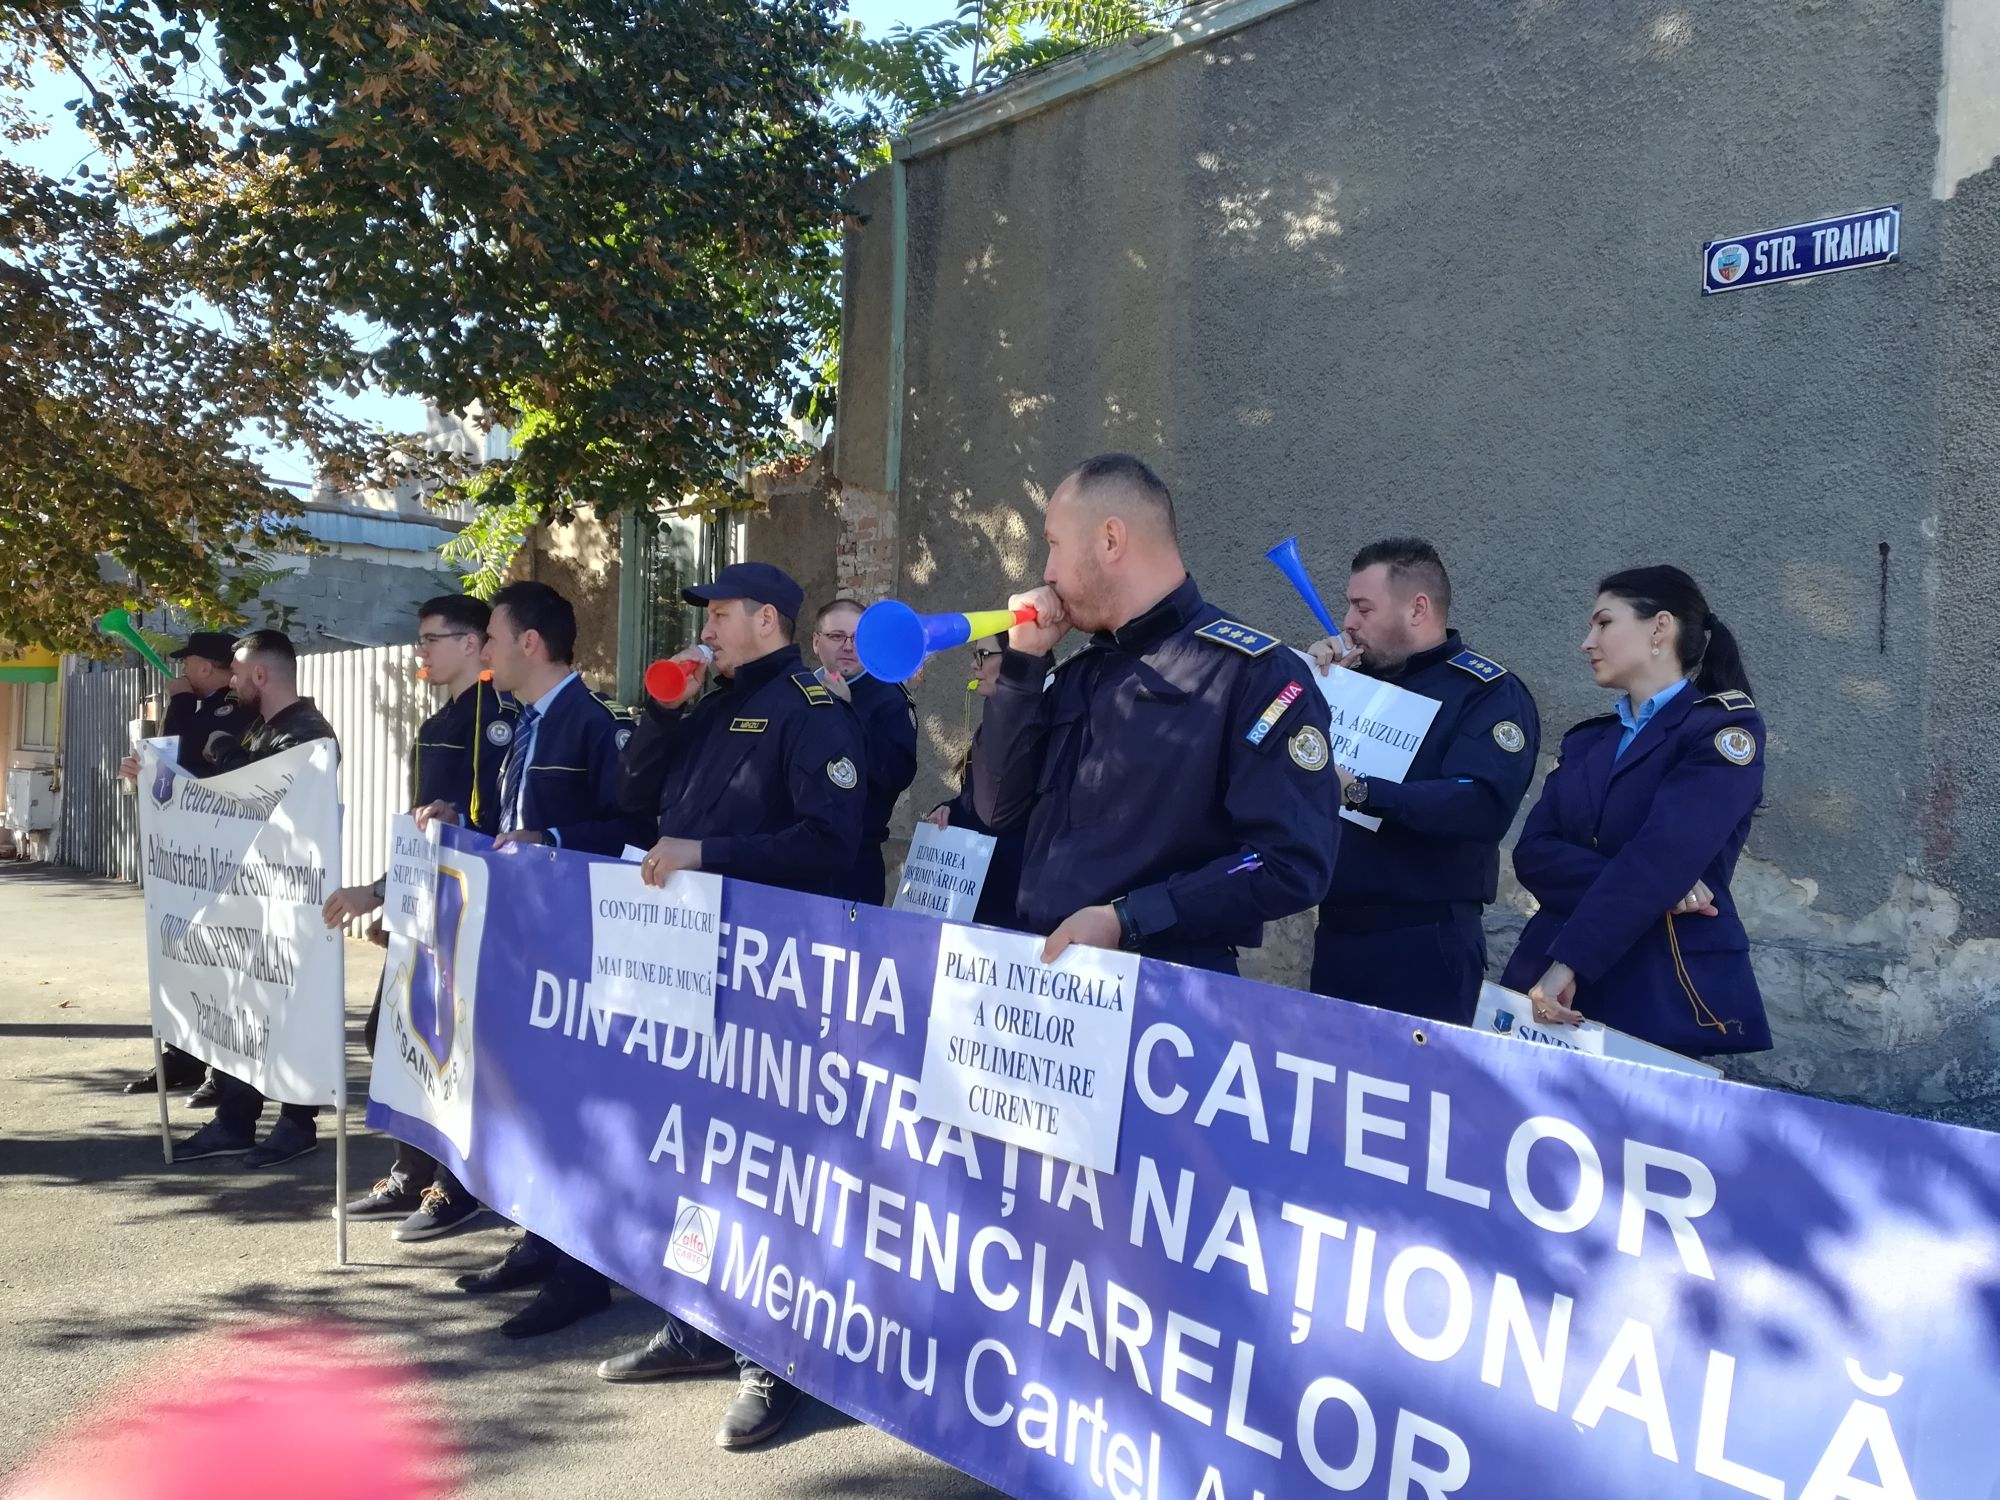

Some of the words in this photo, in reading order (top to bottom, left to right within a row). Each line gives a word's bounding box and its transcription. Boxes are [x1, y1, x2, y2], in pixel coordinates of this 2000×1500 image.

[1754, 235, 1801, 276] STR.
[1812, 216, 1890, 266] TRAIAN
[1349, 715, 1420, 752] ABUZULUI
[148, 833, 208, 901] Administrația
[904, 865, 976, 897] DISCRIMINĂRILOR
[916, 845, 966, 870] ELIMINAREA
[599, 899, 659, 927] CONDIȚII
[664, 906, 679, 927] DE
[681, 909, 715, 934] LUCRU
[597, 956, 622, 976] MAI
[625, 960, 656, 983] BUNE
[659, 965, 673, 987] DE
[675, 969, 712, 997] MUNCĂ
[944, 951, 998, 988] PLATA
[1006, 962, 1124, 1012] INTEGRALĂ
[973, 1002, 985, 1027] A
[995, 1003, 1075, 1048] ORELOR
[947, 1036, 1096, 1099] SUPLIMENTARE
[969, 1084, 1060, 1136] CURENTE
[1134, 1021, 1718, 1281] CATELOR
[529, 969, 613, 1047] DIN
[1130, 1155, 1918, 1500] NAȚIONALĂ
[682, 1232, 704, 1253] alfa
[649, 1103, 687, 1174] A
[701, 1116, 1471, 1500] PENITENCIARELOR
[720, 1222, 937, 1397] Membru
[965, 1338, 1161, 1500] Cartel
